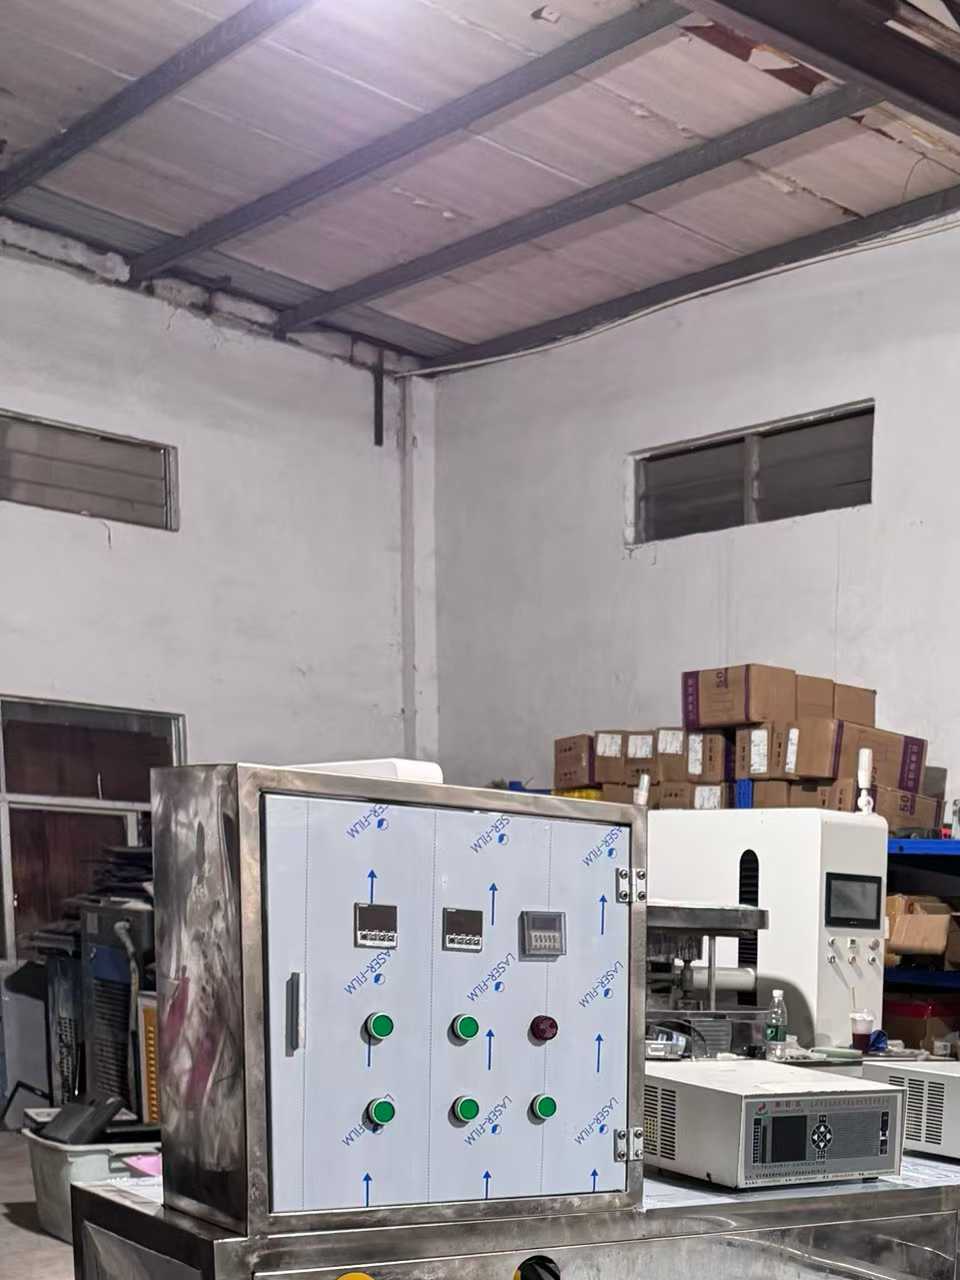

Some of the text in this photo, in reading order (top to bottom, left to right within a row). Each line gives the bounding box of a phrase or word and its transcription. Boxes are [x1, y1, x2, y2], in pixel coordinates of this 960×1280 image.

[467, 953, 516, 1001] LASER-FILM
[579, 961, 624, 1008] LASER-FILM
[464, 1096, 512, 1145] LASER-FILM
[574, 1097, 619, 1144] LASER-FILM
